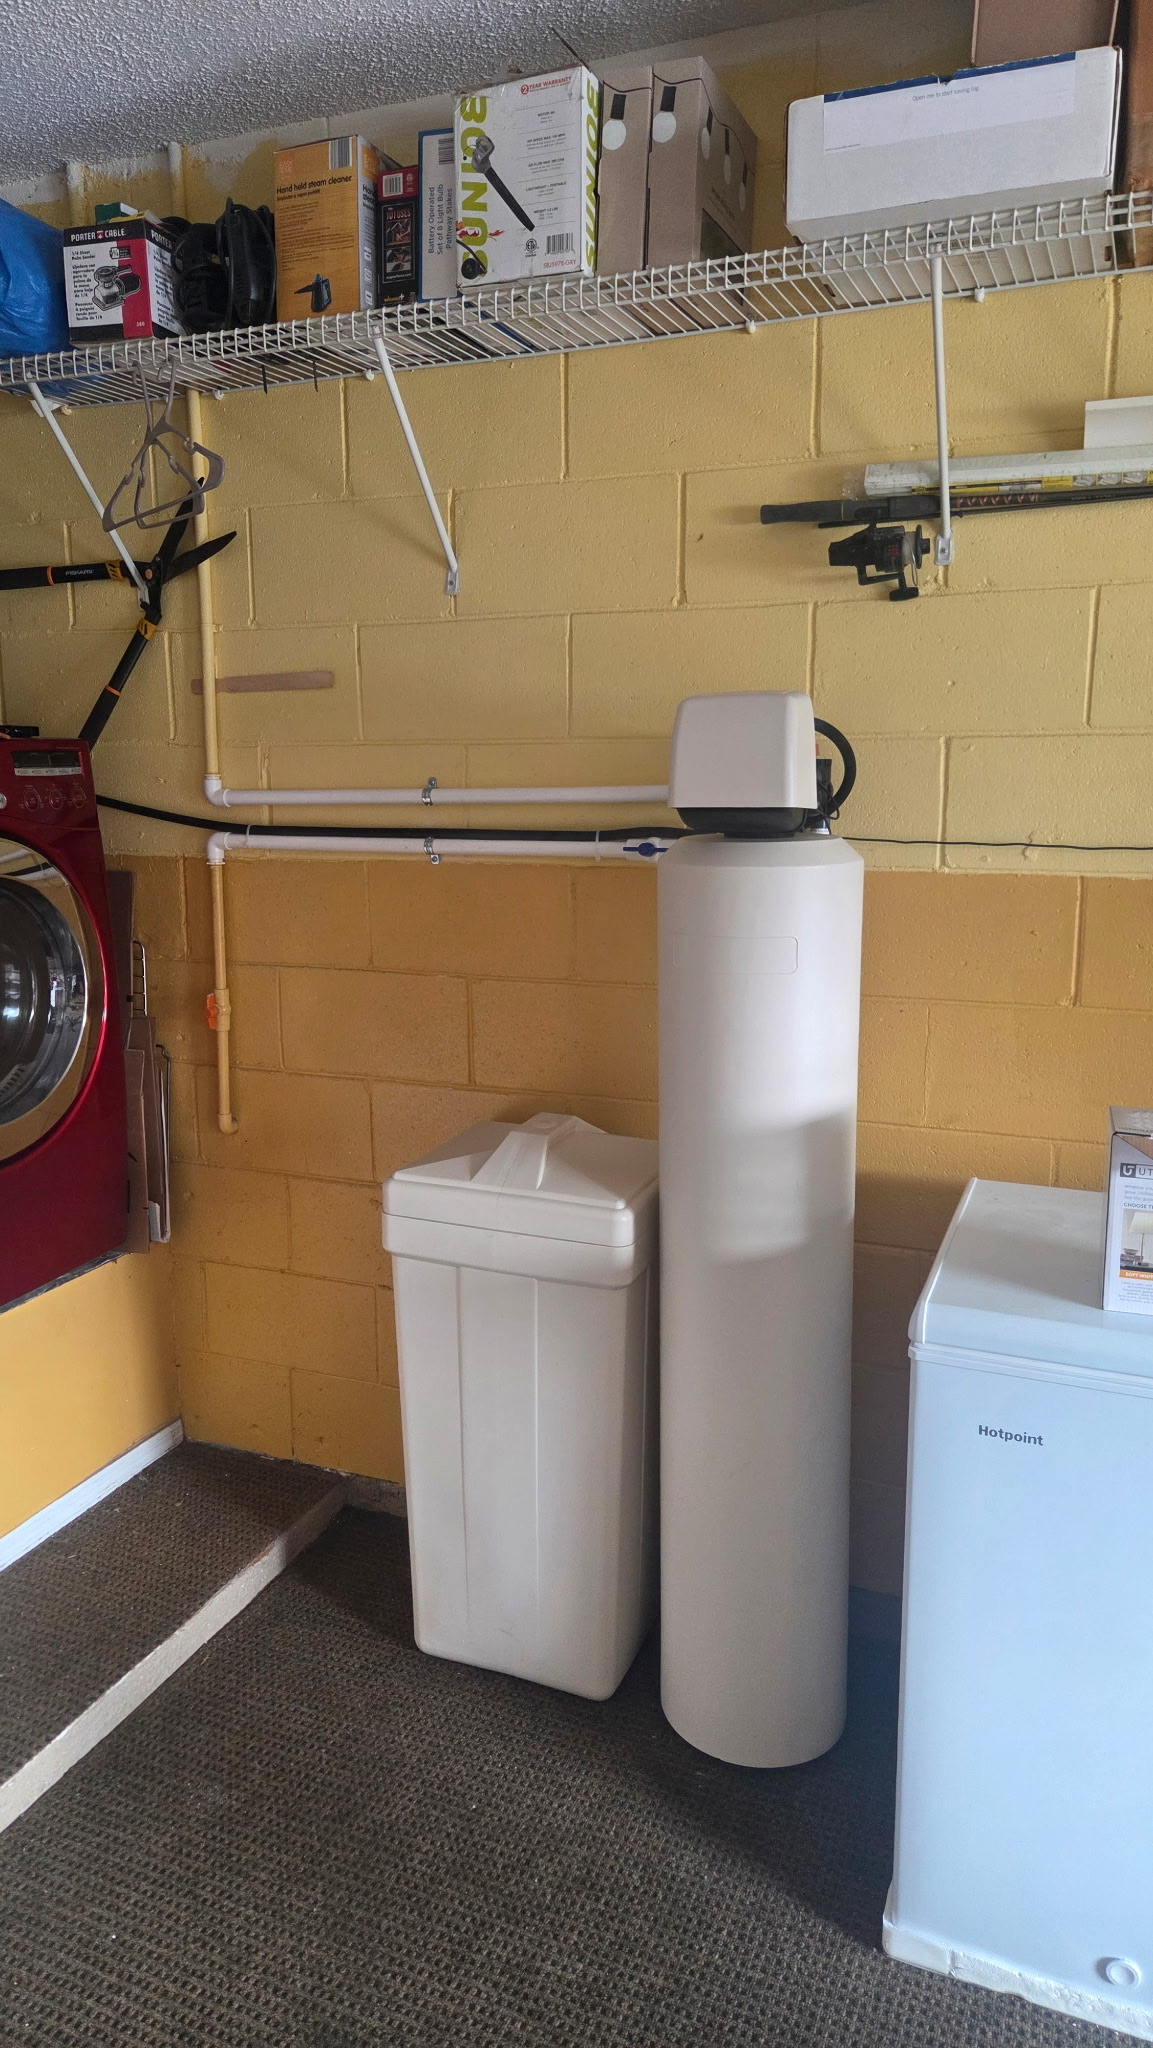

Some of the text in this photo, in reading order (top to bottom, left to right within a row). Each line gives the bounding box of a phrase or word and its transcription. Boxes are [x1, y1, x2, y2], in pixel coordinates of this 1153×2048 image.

[529, 82, 542, 90] YEAR
[542, 76, 571, 87] WARRANTY
[954, 87, 970, 95] saving
[276, 175, 353, 195] Hand held steam cleaner
[396, 208, 412, 219] USES
[437, 204, 445, 224] Light
[71, 228, 126, 242] PORTER CABLE
[428, 225, 436, 254] Battery
[437, 233, 444, 241] of
[446, 216, 454, 249] Pathway
[978, 1424, 1043, 1447] Hotpoint
